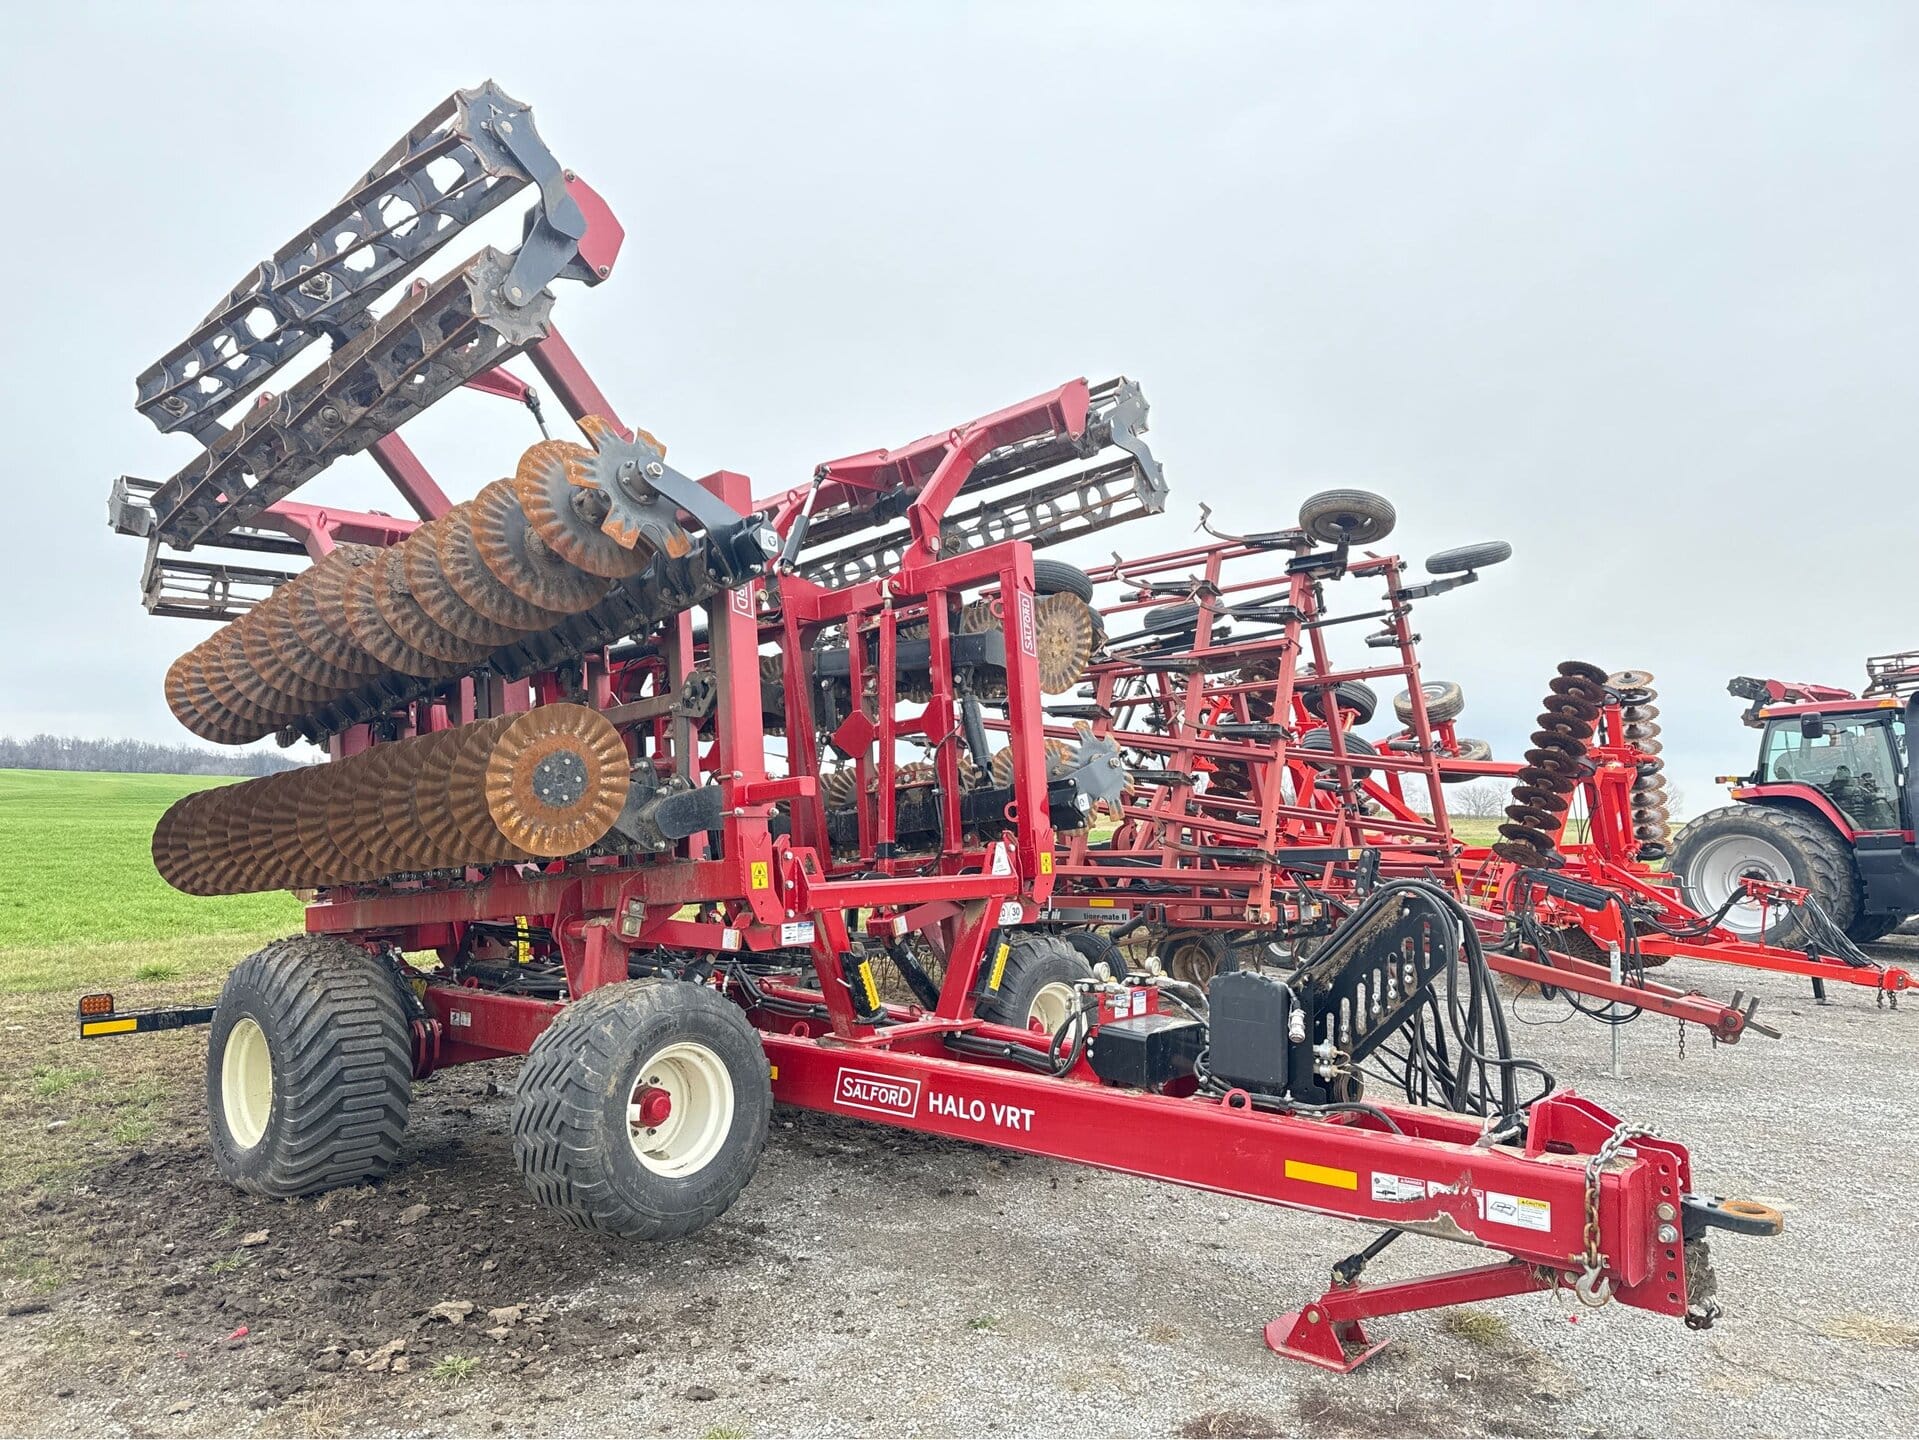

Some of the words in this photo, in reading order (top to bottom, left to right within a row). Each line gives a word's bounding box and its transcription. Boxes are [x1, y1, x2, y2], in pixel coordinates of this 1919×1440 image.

[1021, 598, 1033, 651] SALFORD
[1012, 906, 1020, 917] 30
[841, 1077, 912, 1108] SALFORD
[928, 1091, 986, 1122] HALO
[990, 1102, 1036, 1132] VRT
